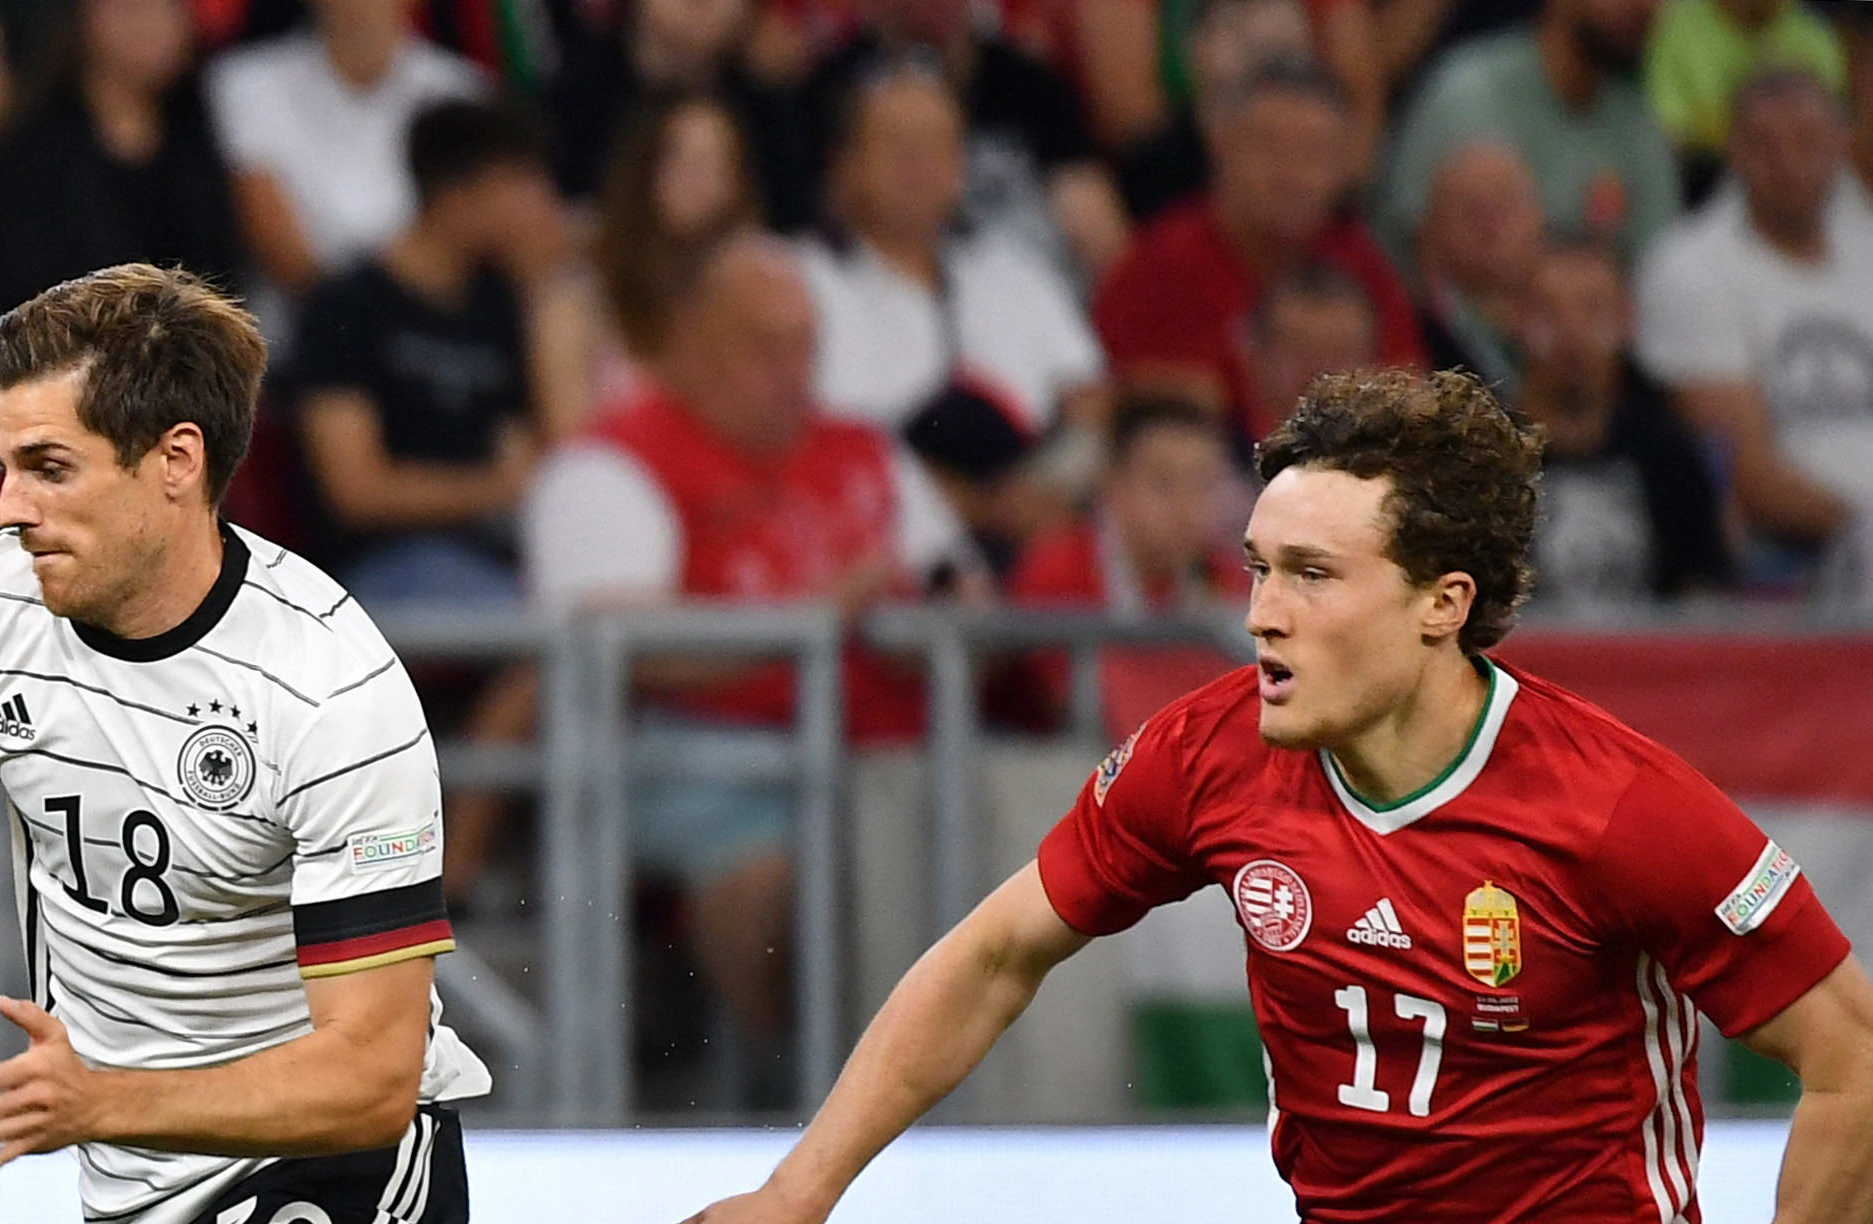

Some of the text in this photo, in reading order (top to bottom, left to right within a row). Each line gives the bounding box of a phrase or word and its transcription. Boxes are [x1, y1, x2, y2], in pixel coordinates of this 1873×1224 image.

[44, 794, 180, 927] 18
[1346, 927, 1413, 950] adidas
[1334, 985, 1447, 1117] 17
